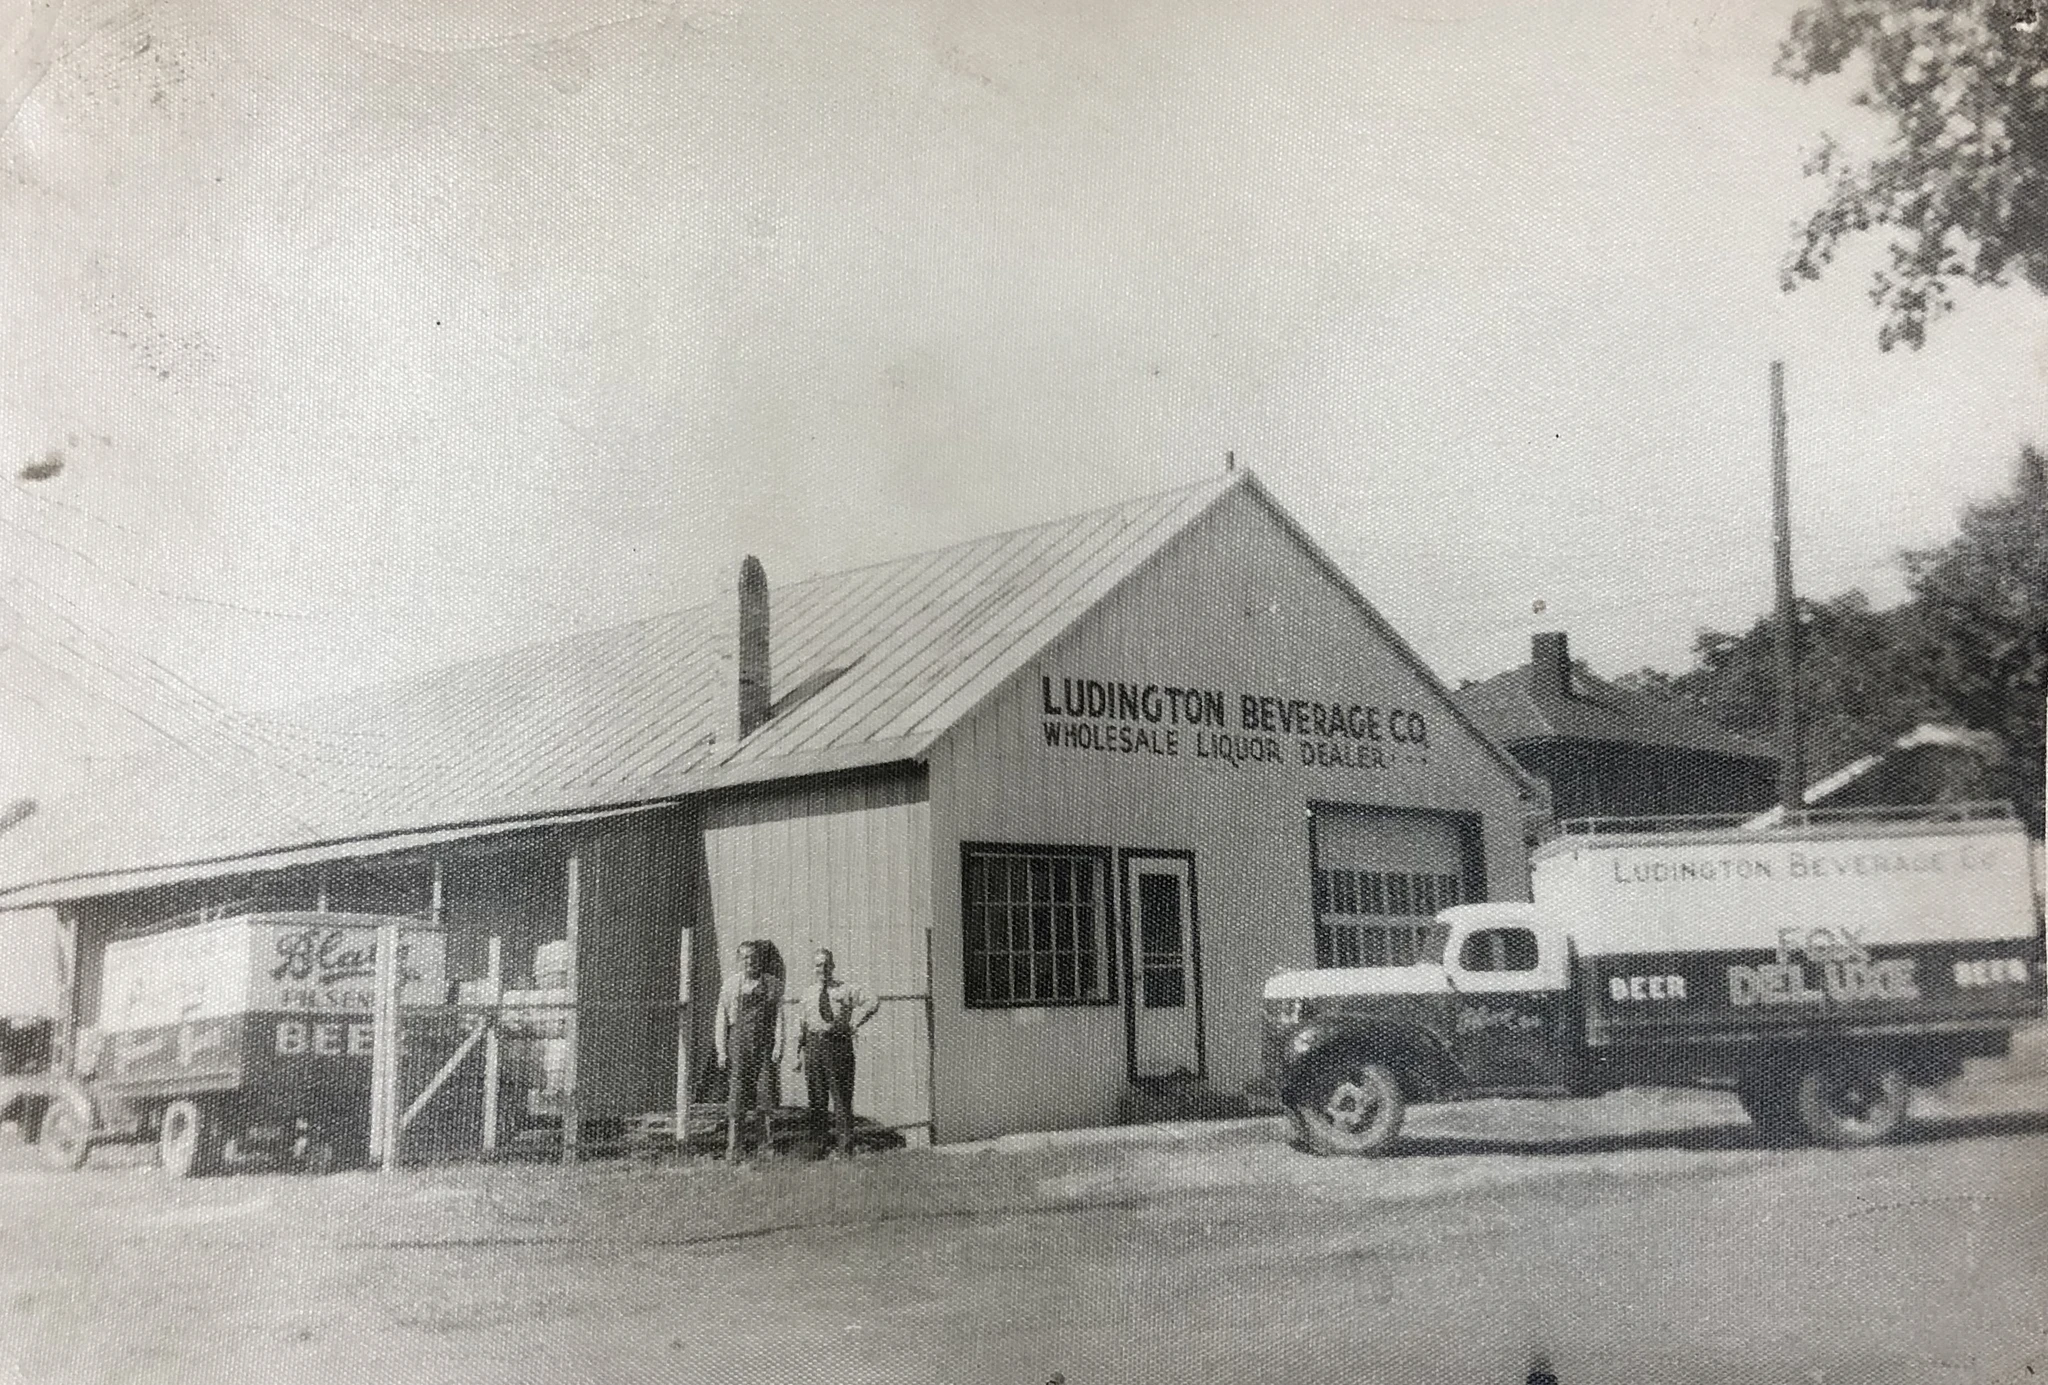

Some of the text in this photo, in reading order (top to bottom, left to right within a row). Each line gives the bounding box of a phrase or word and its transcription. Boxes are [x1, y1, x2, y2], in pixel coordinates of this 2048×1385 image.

[1042, 676, 1225, 727] LUDINGTON
[1241, 694, 1382, 741] BEVERAGE
[1042, 721, 1179, 756] WHOLESALE
[1196, 733, 1284, 768] LIQUOR
[1776, 925, 1871, 964] FOX
[1609, 974, 1688, 1002] BEER
